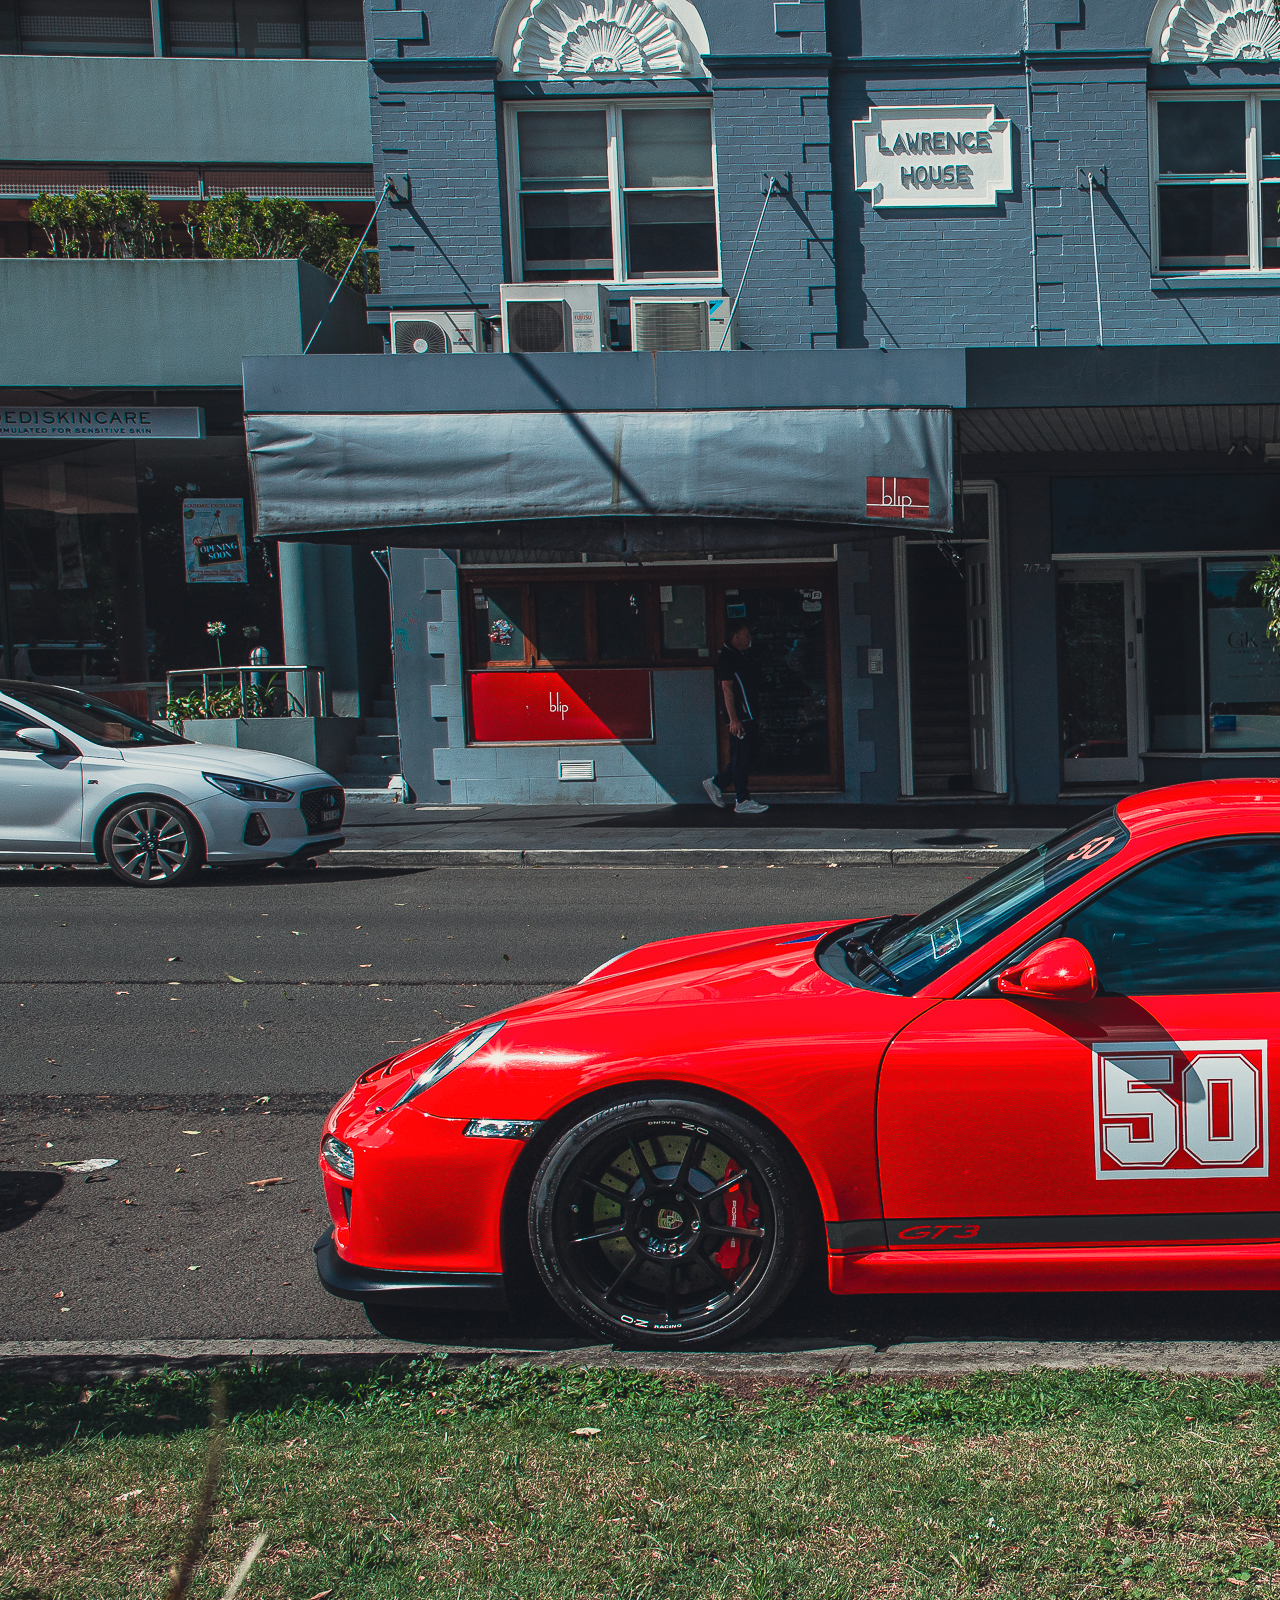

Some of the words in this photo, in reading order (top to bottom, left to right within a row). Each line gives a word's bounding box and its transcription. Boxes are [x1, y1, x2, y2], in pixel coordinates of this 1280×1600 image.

[877, 131, 990, 153] LAWRENCE
[901, 165, 971, 186] HOUSE
[574, 313, 592, 321] FUJITSU
[0, 411, 151, 424] EDISKINCARE
[881, 476, 912, 519] blip
[200, 542, 238, 553] OPENING
[208, 551, 232, 560] SOON
[549, 691, 569, 720] blip
[1066, 836, 1116, 861] 50
[586, 1099, 648, 1127] MICHELIN
[1101, 1053, 1260, 1168] 50
[730, 1200, 738, 1248] PORSE
[898, 1224, 980, 1240] GT3
